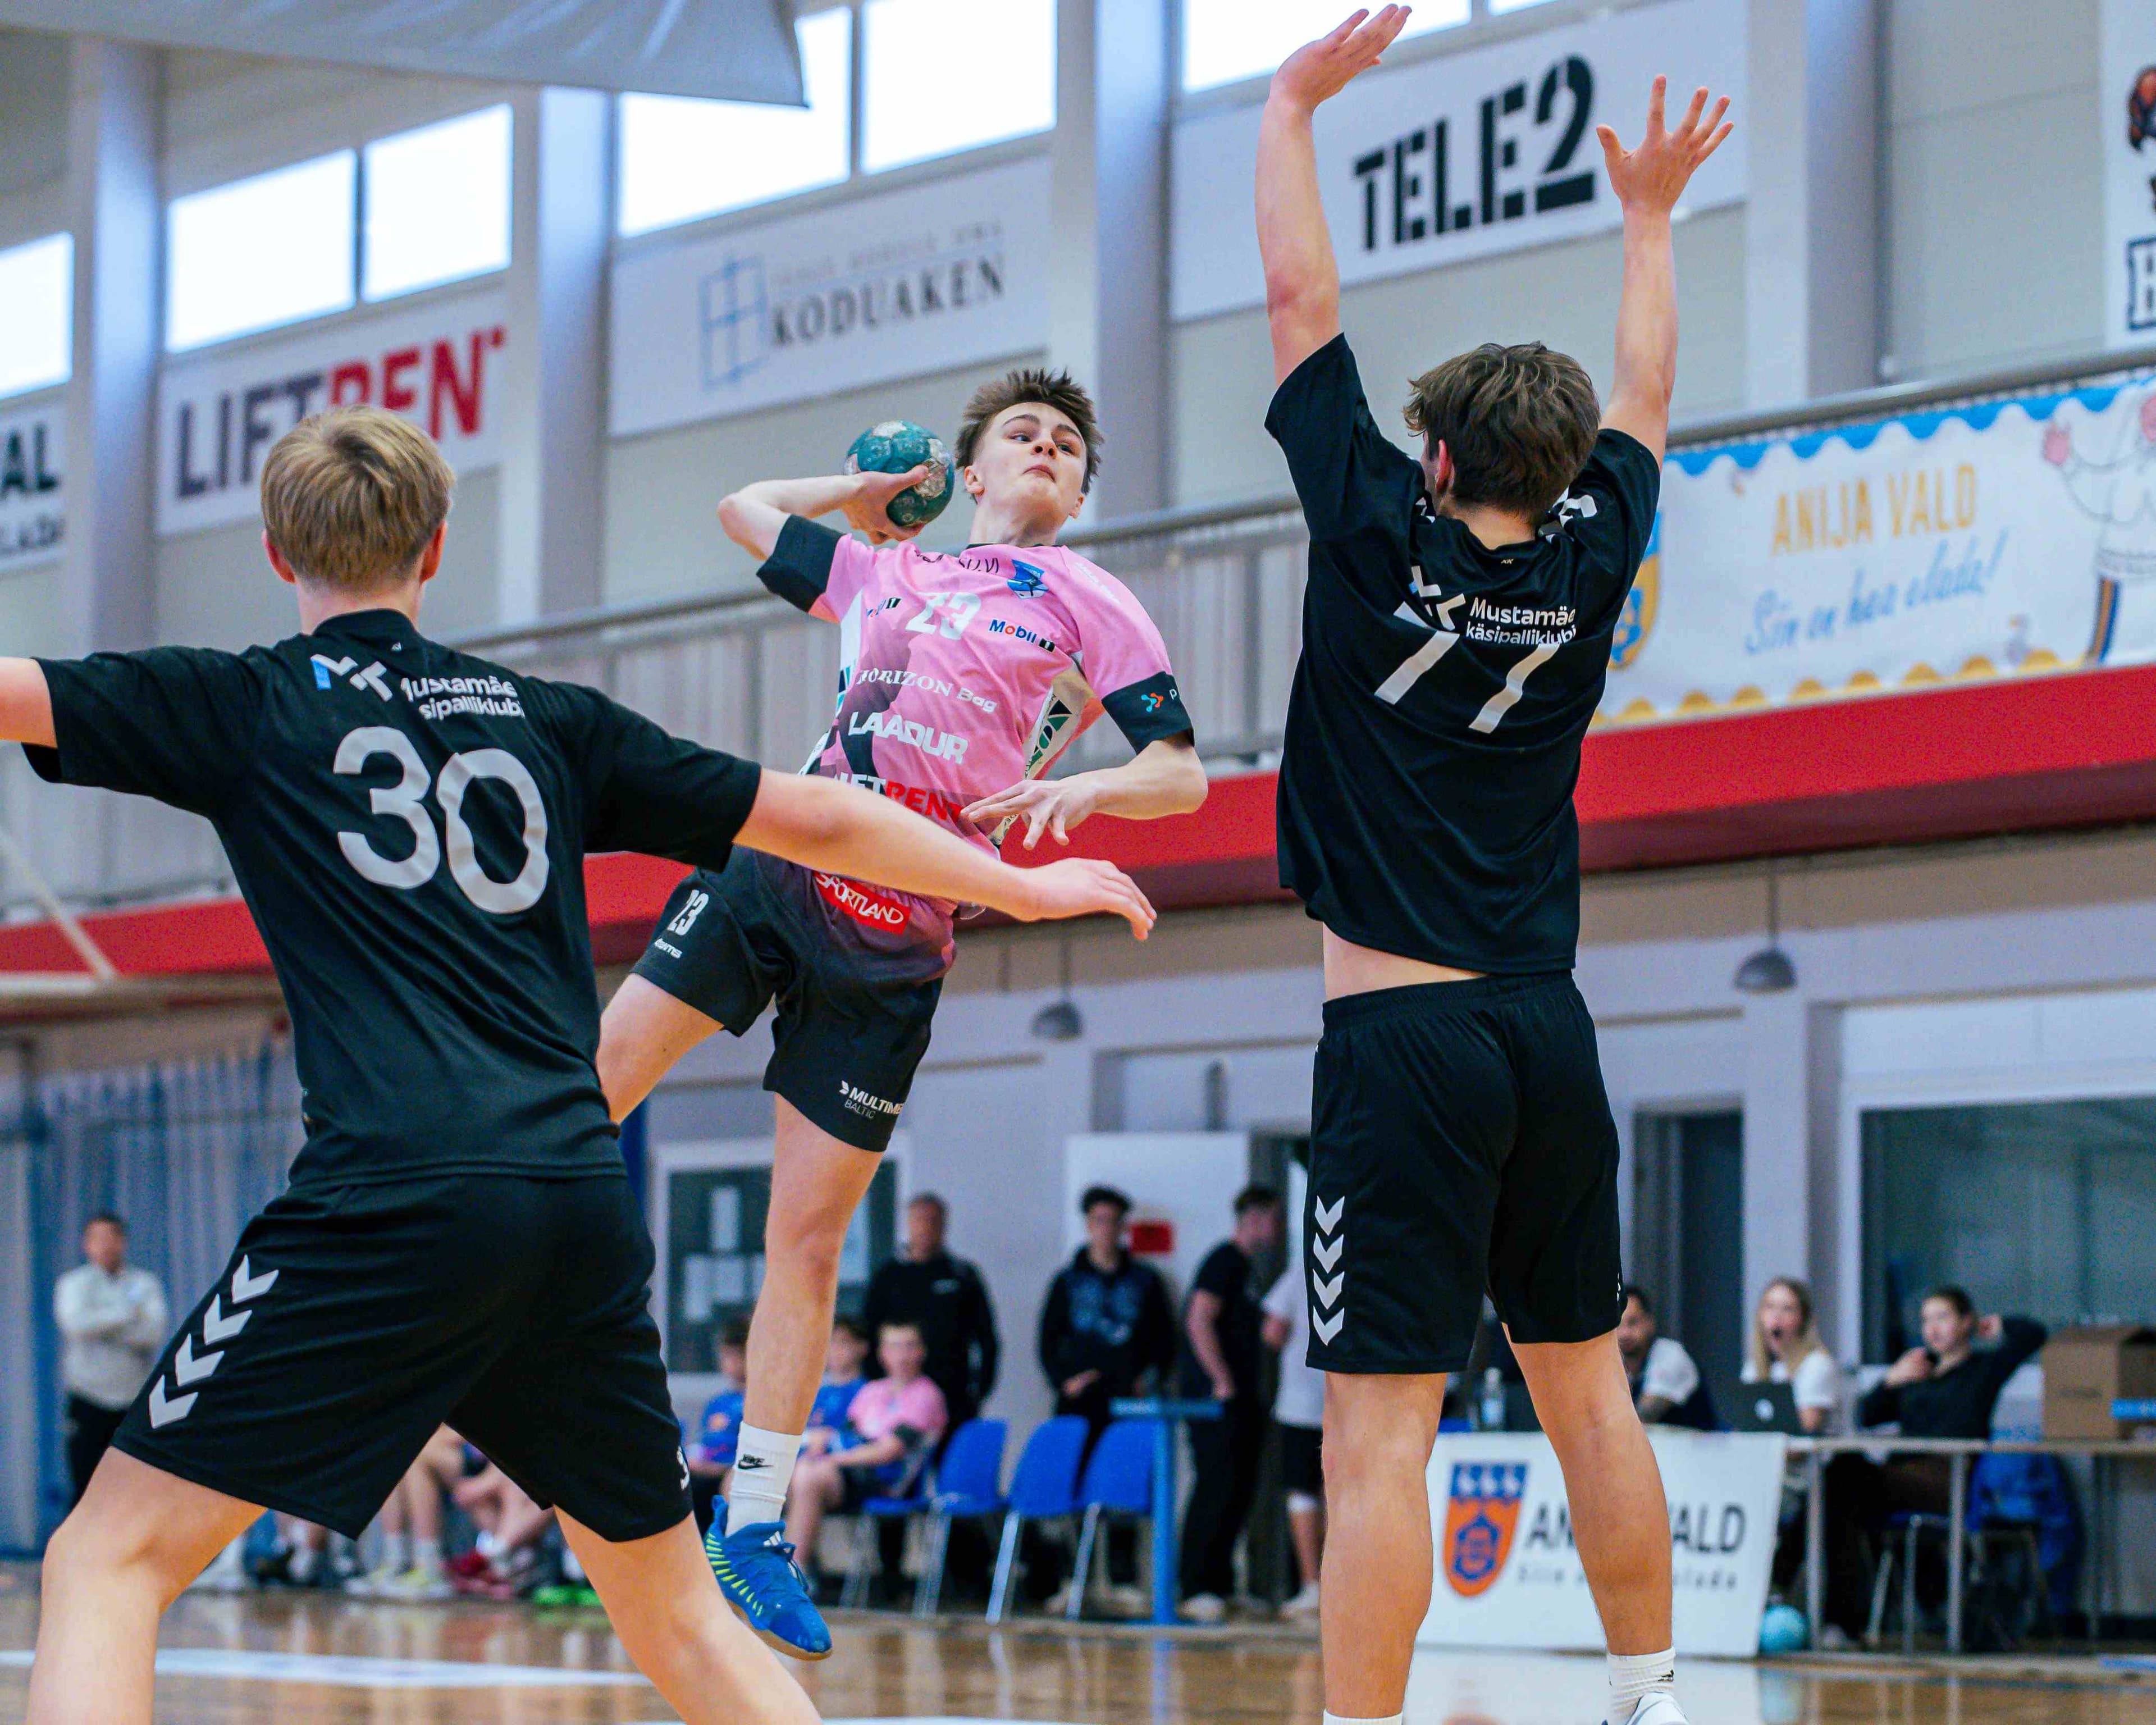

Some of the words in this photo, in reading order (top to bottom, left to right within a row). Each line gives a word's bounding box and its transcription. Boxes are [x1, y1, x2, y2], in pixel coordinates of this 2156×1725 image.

[1354, 53, 1596, 251] TELE2
[1771, 477, 1873, 557] ANIJA
[1886, 463, 1975, 537] VALD
[905, 591, 981, 640] 23
[989, 619, 1037, 644] Mobil
[1465, 621, 1577, 646] käsipalliklubi
[1470, 597, 1575, 626] Mustamäe
[956, 686, 998, 714] Bag
[848, 711, 968, 764] LAADUR
[334, 725, 549, 914] 30
[666, 889, 709, 935] 23
[815, 874, 904, 924] SPORTLAND
[844, 1099, 876, 1119] BALTIC
[1670, 1502, 1746, 1553] ALD
